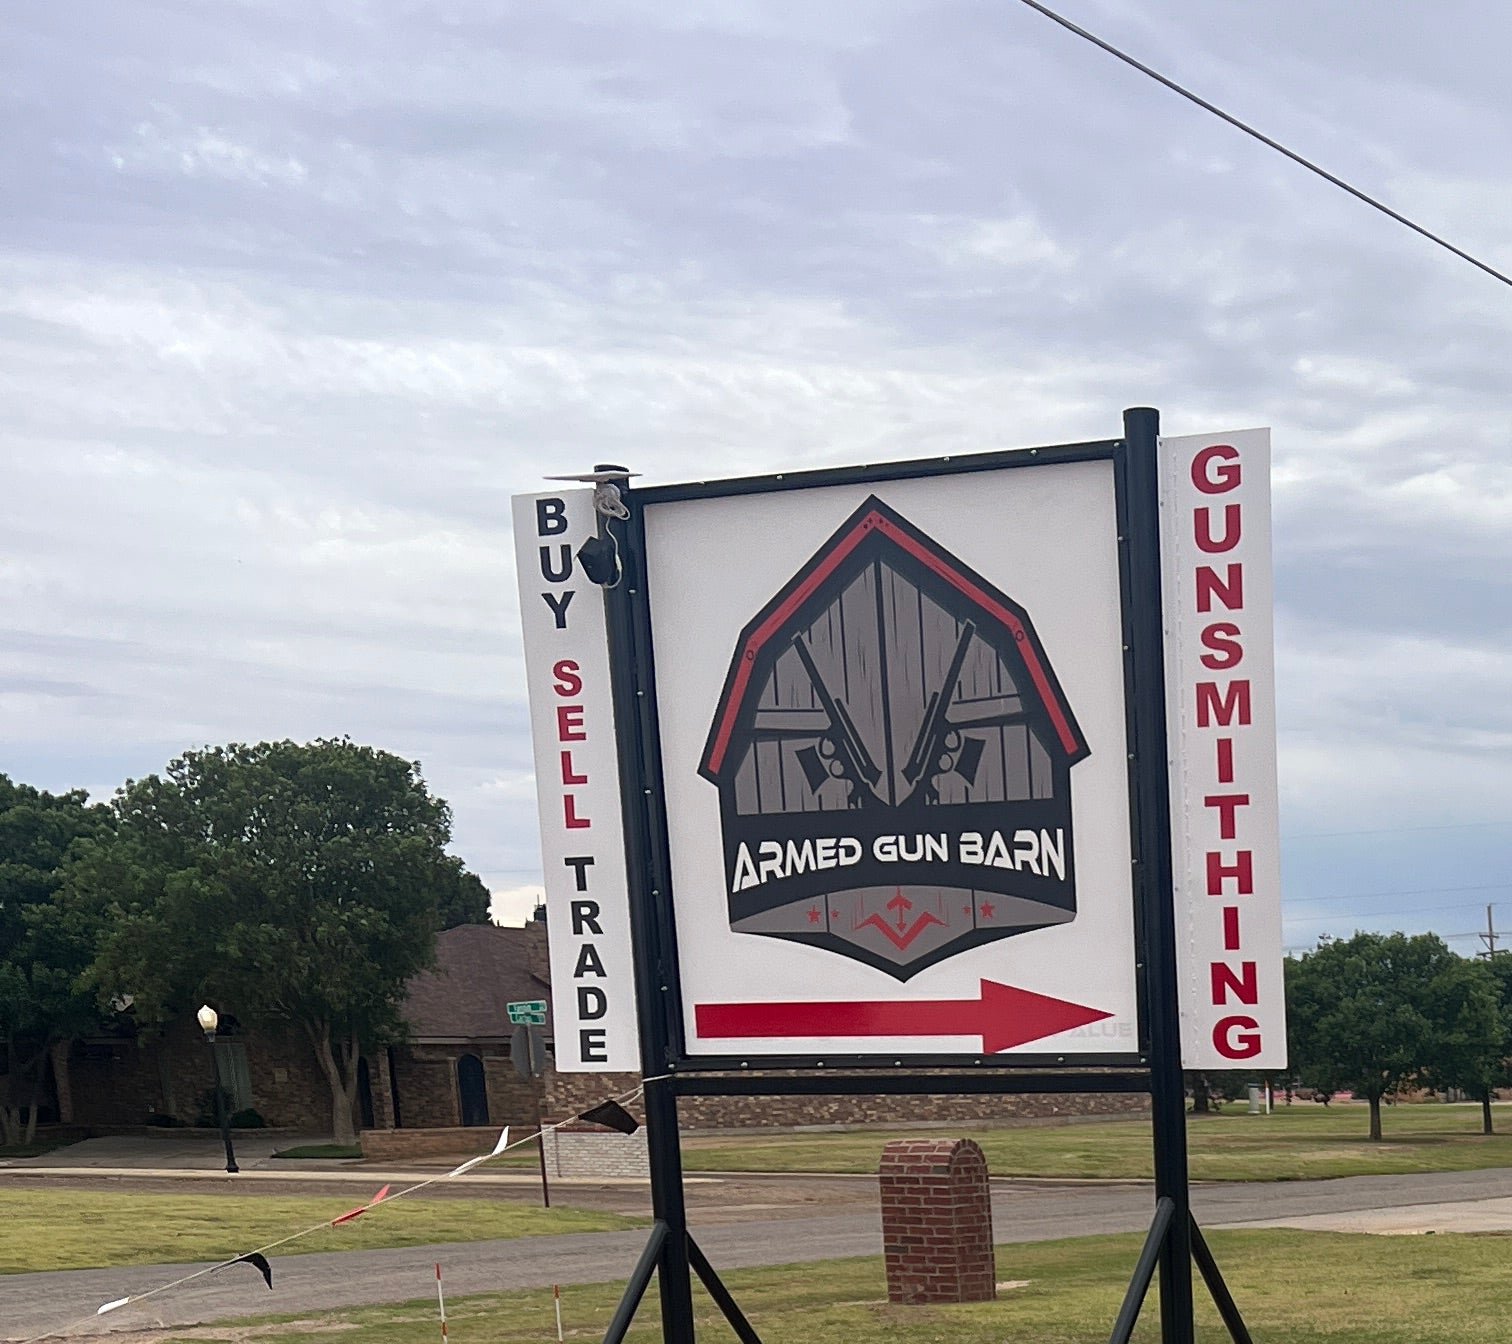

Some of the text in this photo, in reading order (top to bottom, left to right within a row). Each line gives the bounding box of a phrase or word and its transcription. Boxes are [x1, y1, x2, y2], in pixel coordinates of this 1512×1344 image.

[535, 497, 608, 1063] BUY SELL TRADE
[732, 828, 1066, 893] ARMED GUN BARN
[1191, 445, 1263, 1061] GUNSMITHING
